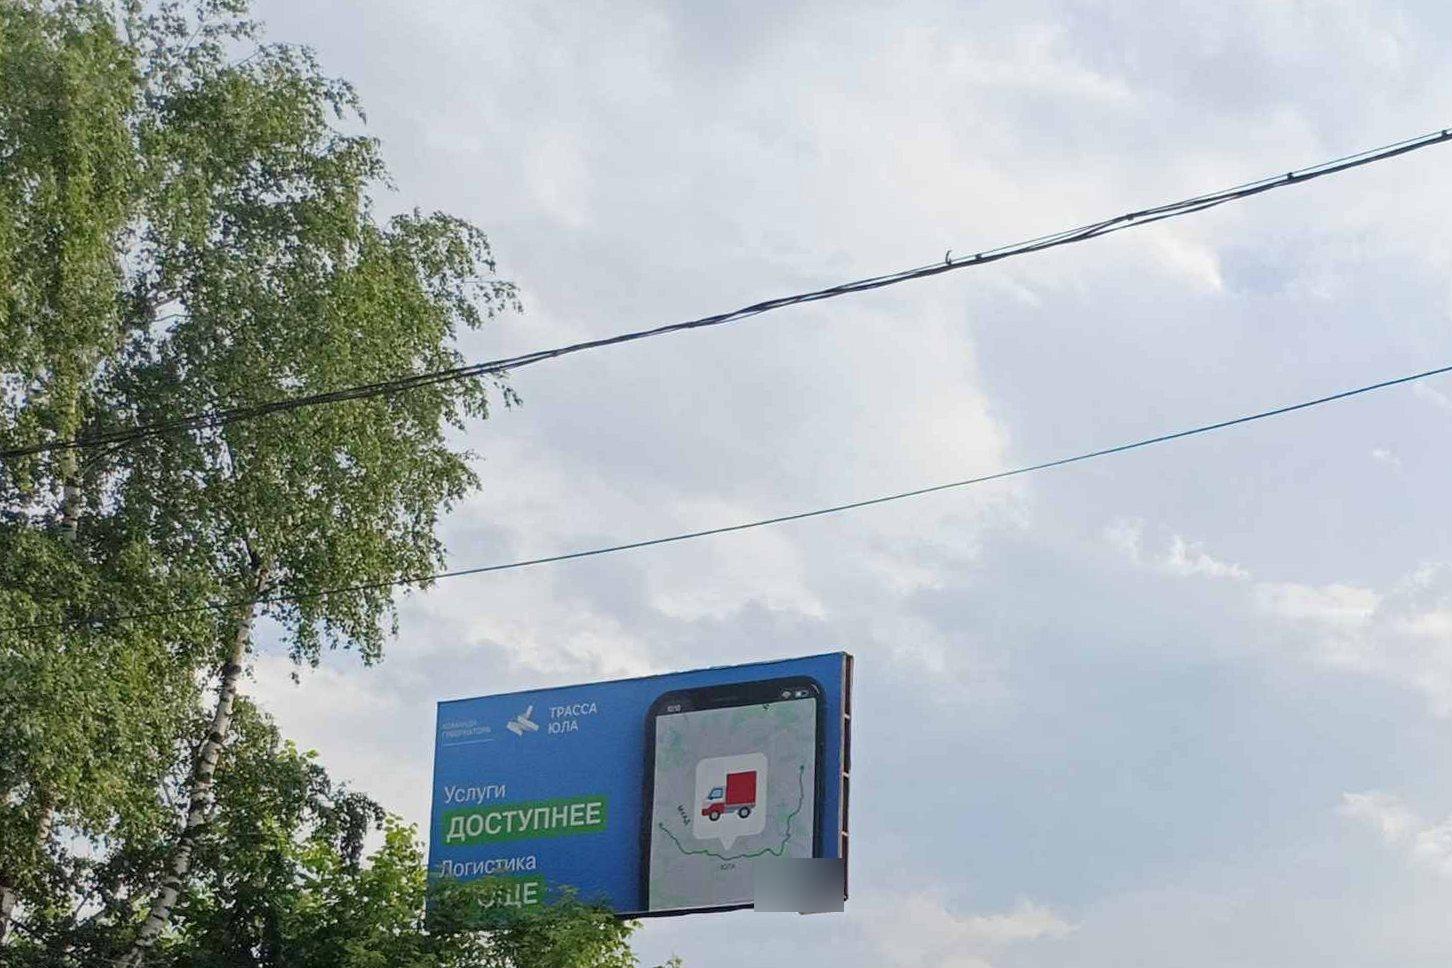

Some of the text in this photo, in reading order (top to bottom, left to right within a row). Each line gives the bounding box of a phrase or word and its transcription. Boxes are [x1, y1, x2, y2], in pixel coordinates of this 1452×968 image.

[549, 703, 597, 718] ТРАССА
[548, 720, 578, 734] ЮЛА
[444, 785, 506, 804] Услуги
[446, 802, 602, 843] ДОСТУПНЕЕ
[439, 855, 537, 878] Логистика
